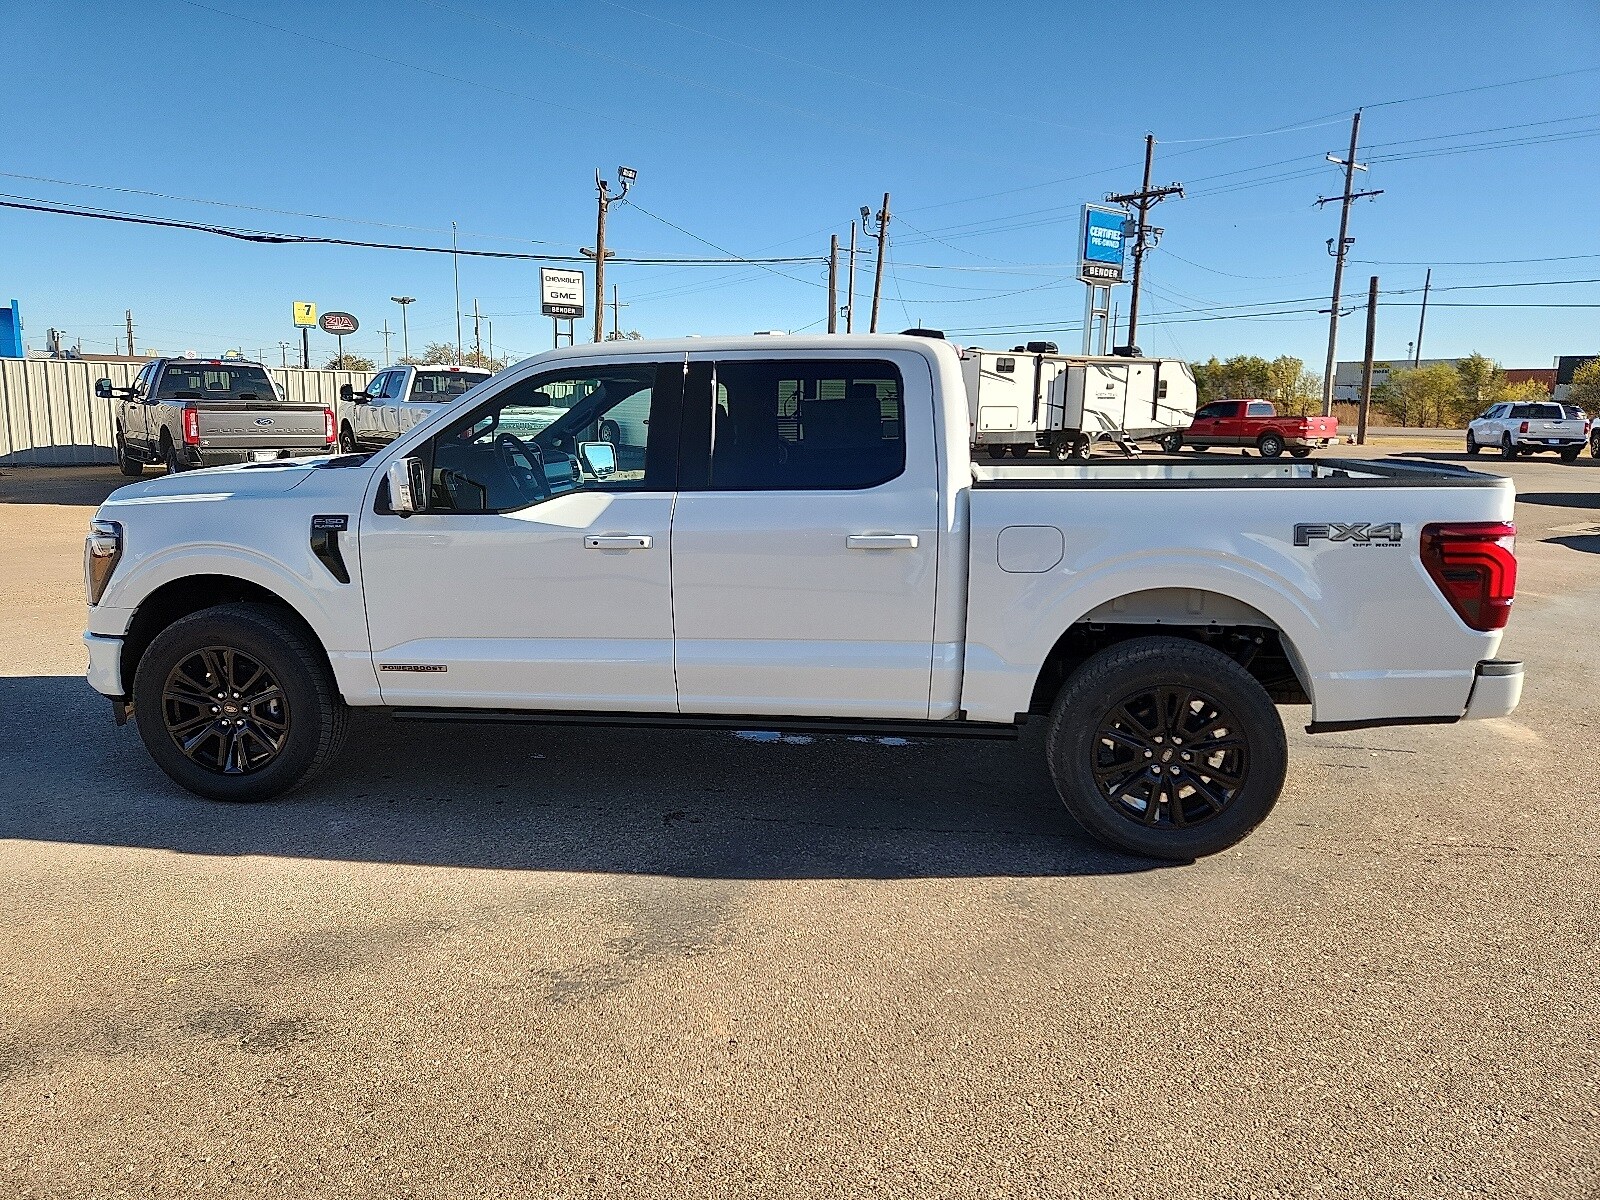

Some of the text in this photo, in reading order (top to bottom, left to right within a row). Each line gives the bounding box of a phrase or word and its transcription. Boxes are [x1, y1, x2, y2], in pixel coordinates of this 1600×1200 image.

[1089, 266, 1119, 278] BENDER
[545, 275, 581, 284] CHEVROLET
[550, 291, 577, 300] GMC
[304, 304, 312, 316] 7
[551, 306, 576, 314] BENDER
[1293, 522, 1403, 546] FX4
